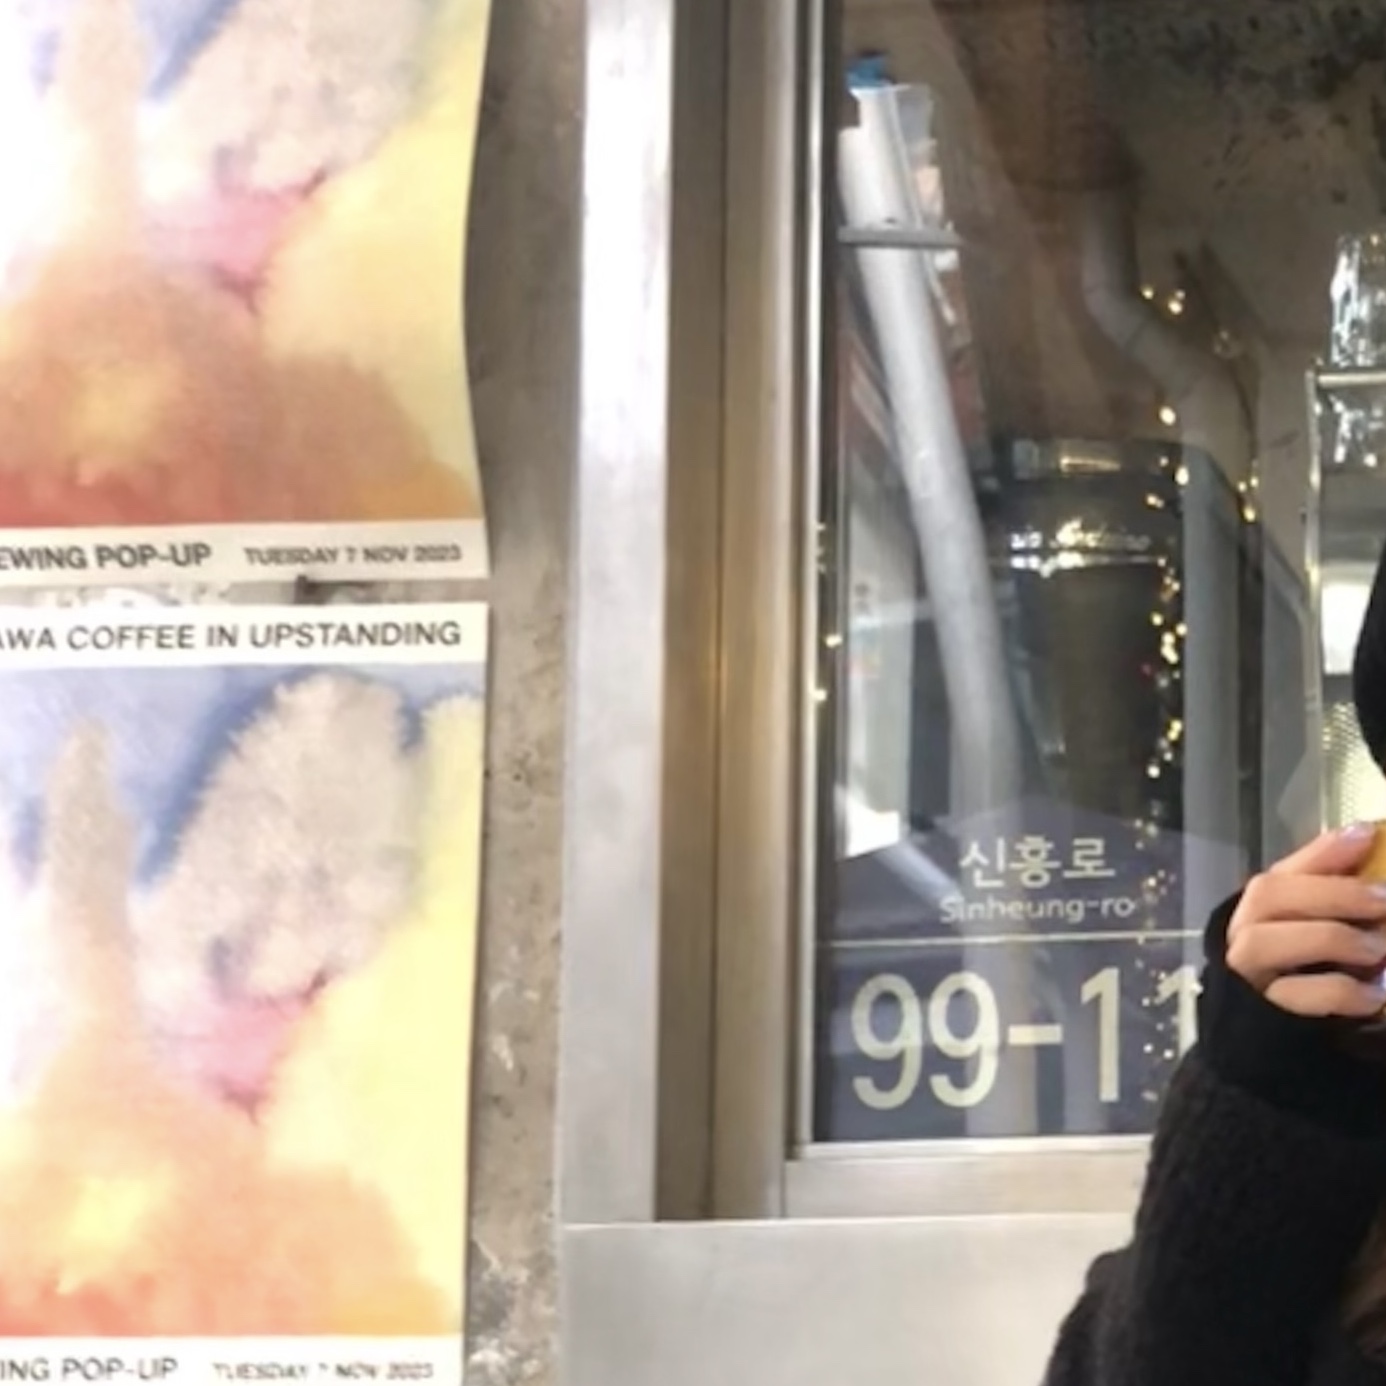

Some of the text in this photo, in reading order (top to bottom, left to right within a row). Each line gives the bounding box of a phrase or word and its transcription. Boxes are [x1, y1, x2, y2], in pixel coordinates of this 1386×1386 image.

[95, 542, 212, 569] POP-UP
[243, 547, 339, 566] TUESDAY
[362, 547, 408, 564] NOV
[0, 620, 462, 650] WA COFFEE IN UPSTANDING
[959, 835, 1116, 889] 신흥로
[938, 895, 1137, 924] Sinheung-ro
[850, 964, 1203, 1110] 99-11
[61, 1356, 178, 1381] POP-UP
